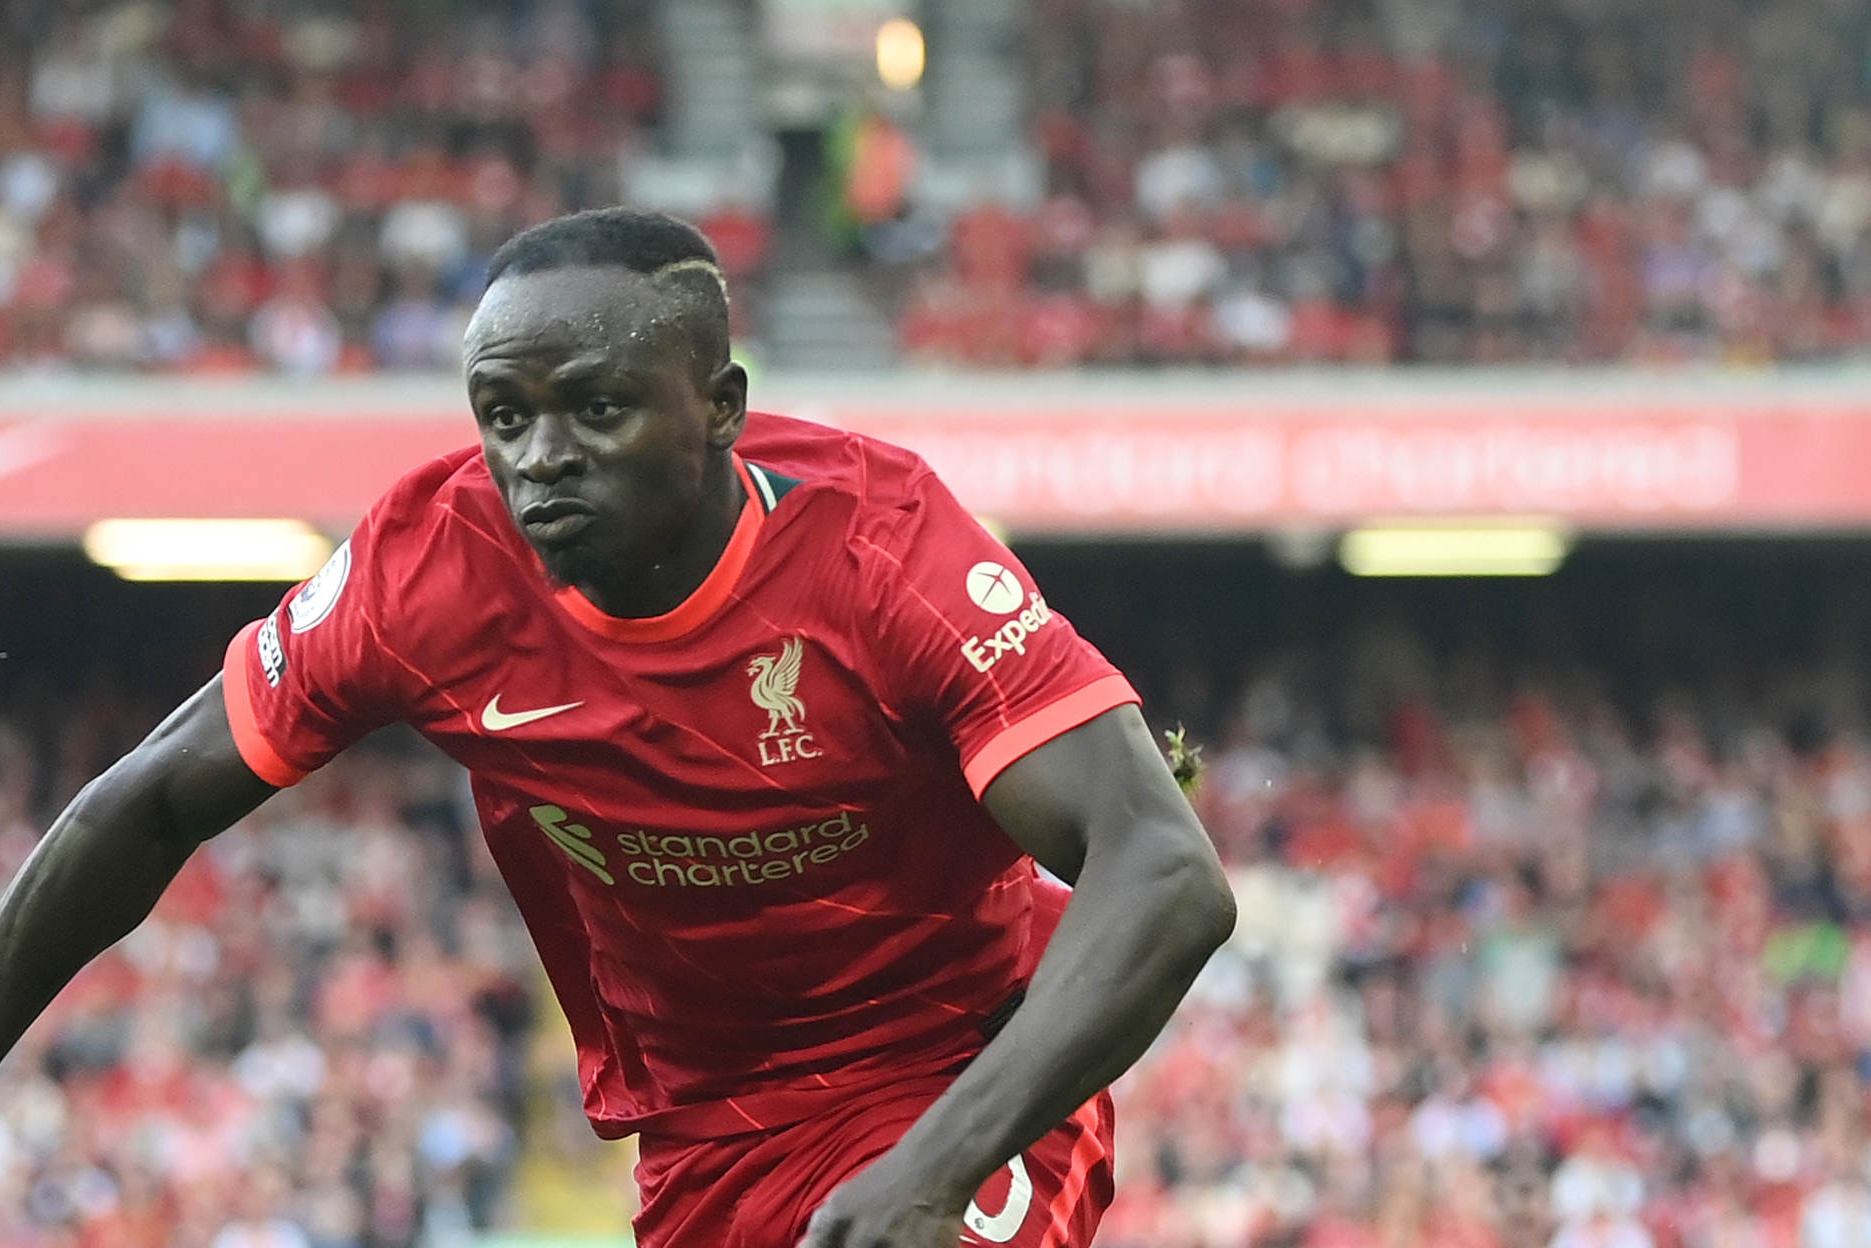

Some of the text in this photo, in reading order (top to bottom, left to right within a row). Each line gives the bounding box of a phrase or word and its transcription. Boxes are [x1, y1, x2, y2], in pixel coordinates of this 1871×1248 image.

[758, 735, 823, 766] L.F.C.
[617, 811, 851, 858] standard
[628, 823, 869, 886] chartered
